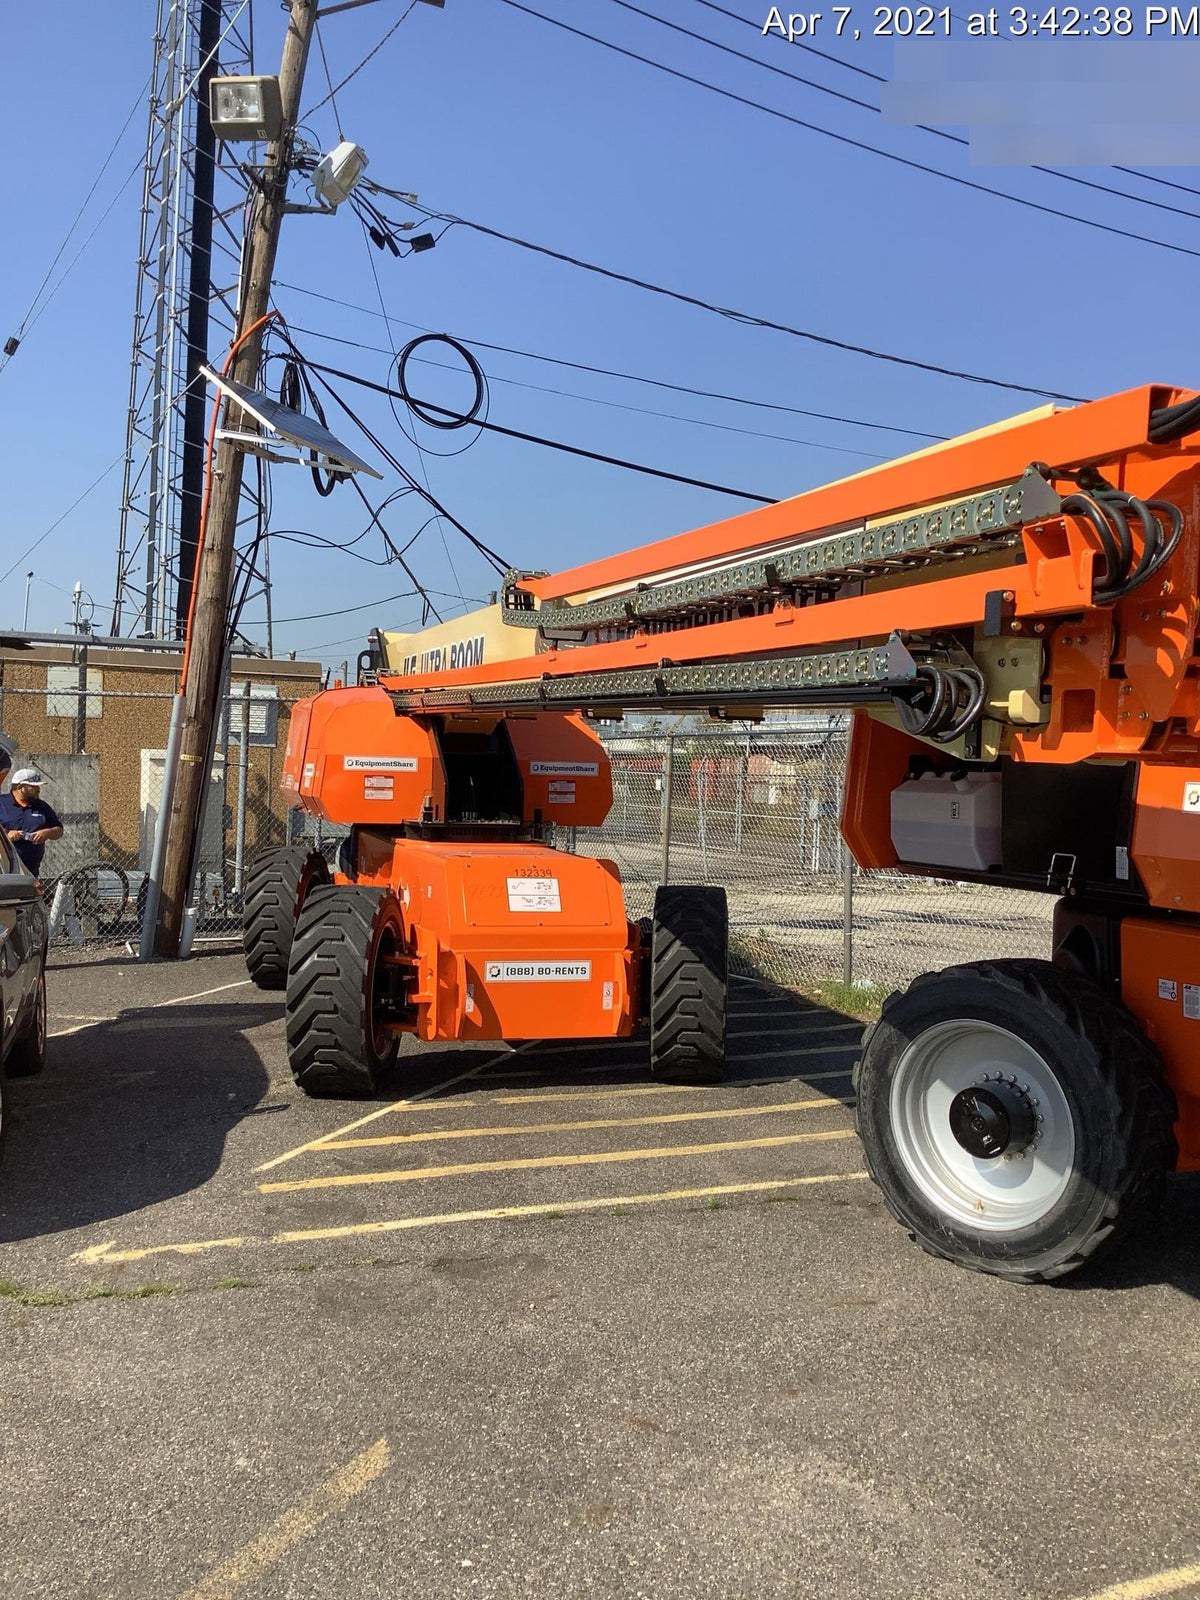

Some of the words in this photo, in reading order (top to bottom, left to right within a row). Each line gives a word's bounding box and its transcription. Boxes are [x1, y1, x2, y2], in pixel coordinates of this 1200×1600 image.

[450, 636, 485, 669] BOOM
[355, 759, 414, 768] EquipmentShare
[540, 764, 595, 772] EquipmentShare
[514, 868, 552, 877] 132339
[506, 967, 534, 976] (888)
[537, 966, 587, 976] 80-RENTS
